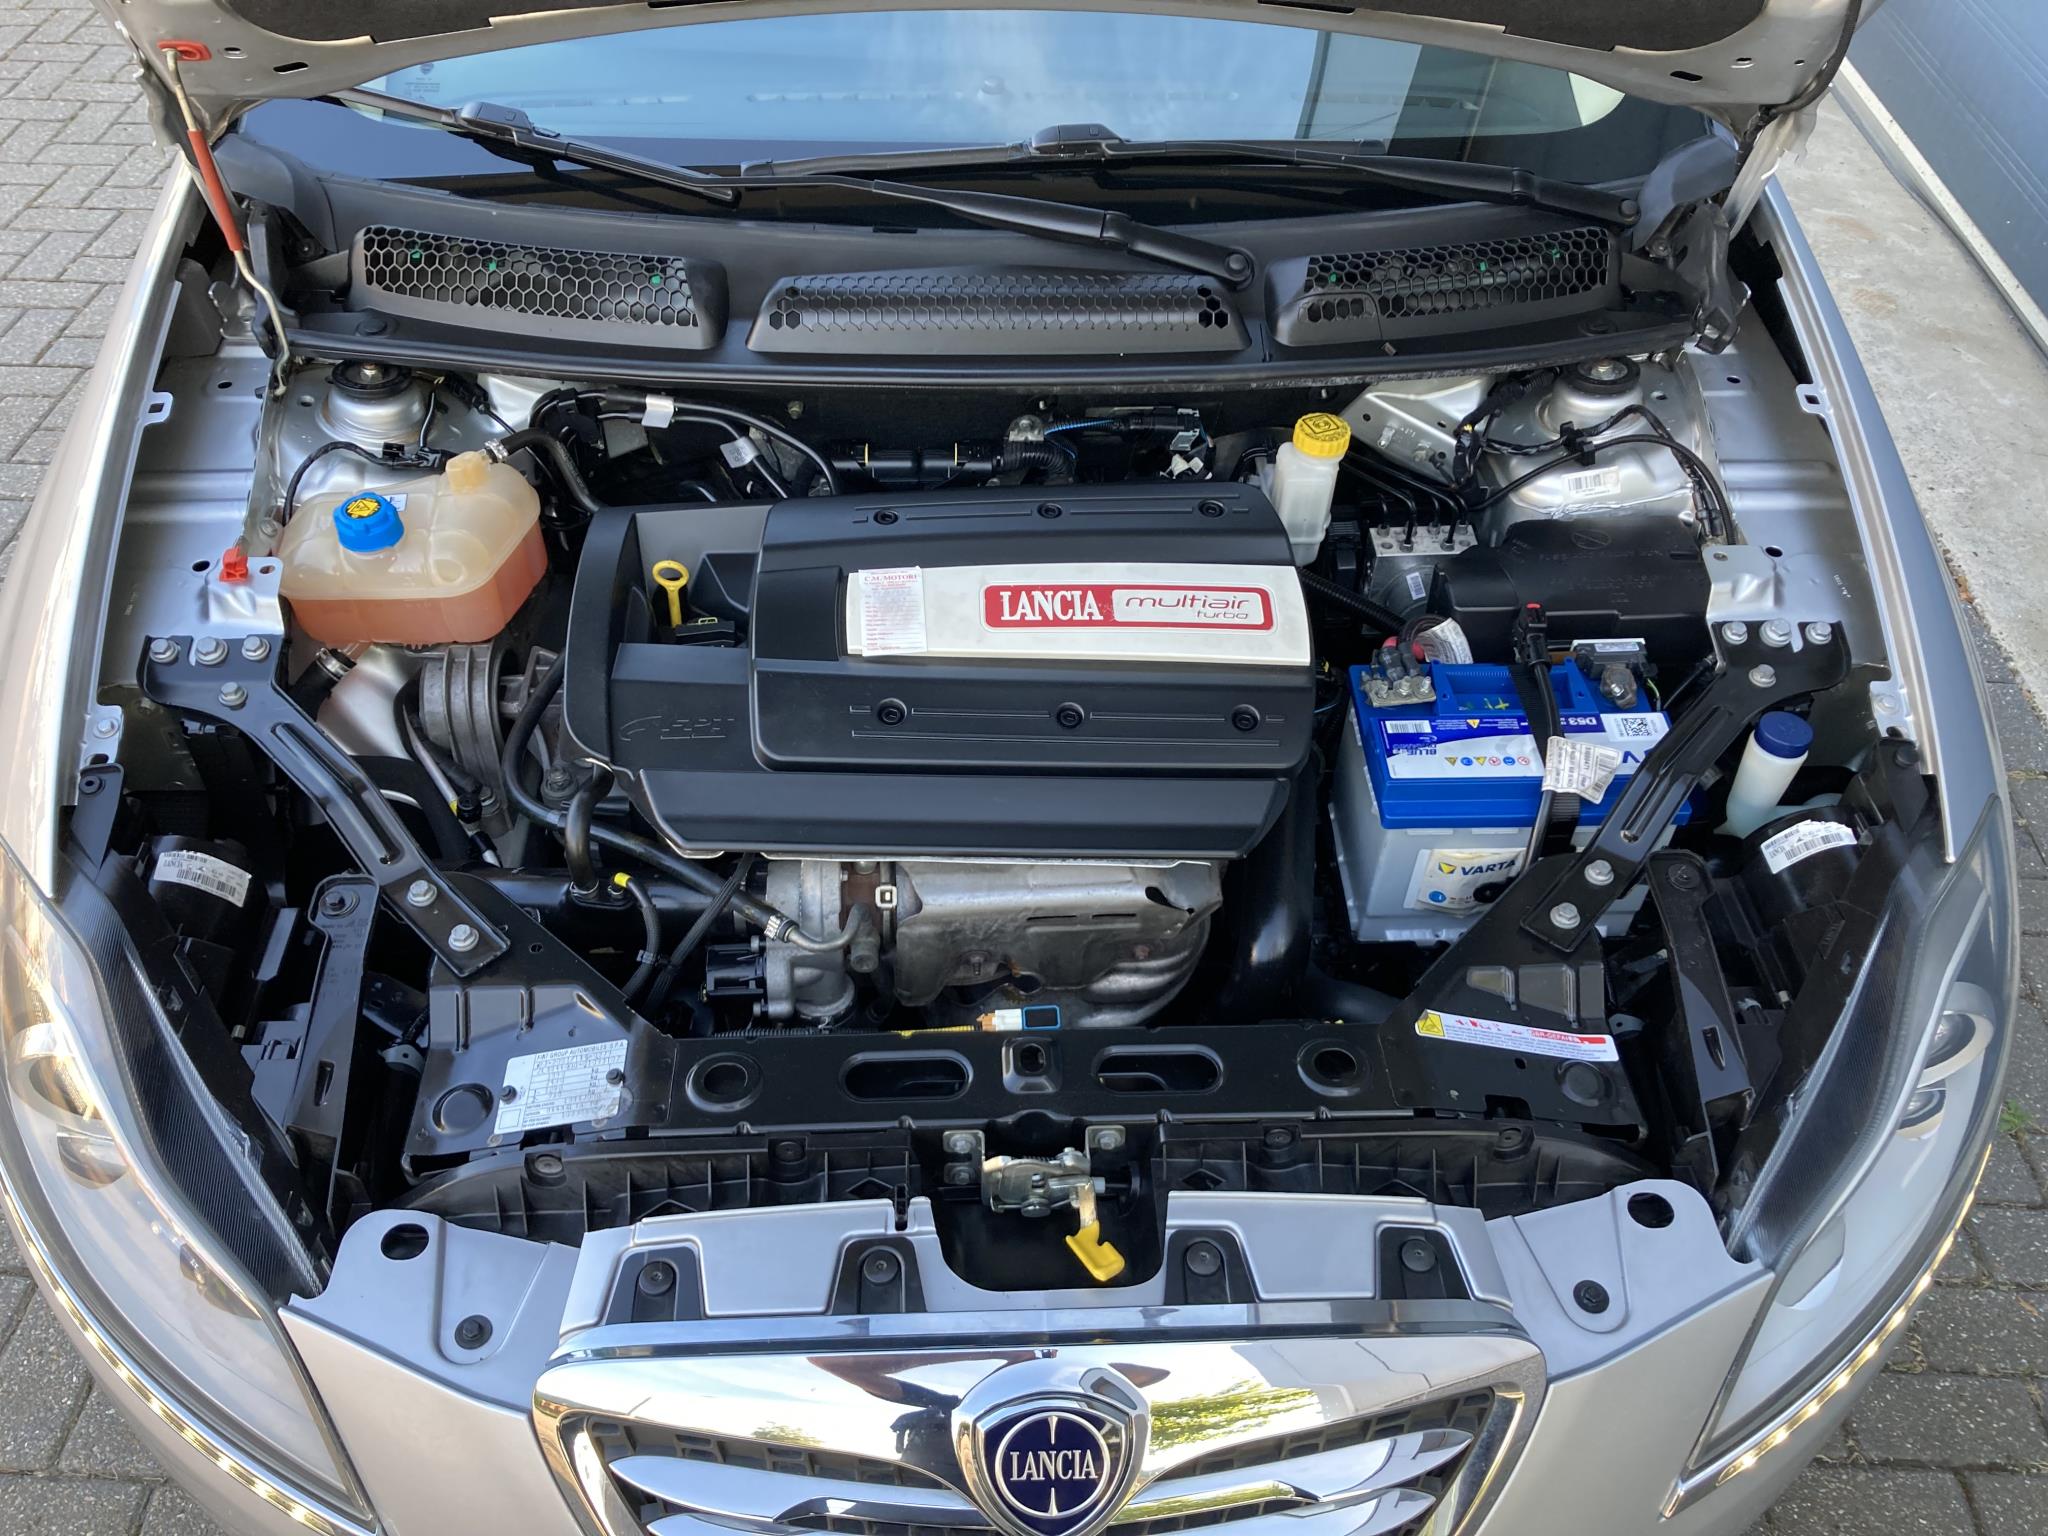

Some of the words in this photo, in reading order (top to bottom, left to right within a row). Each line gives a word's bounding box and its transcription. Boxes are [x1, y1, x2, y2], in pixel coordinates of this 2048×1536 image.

[999, 590, 1104, 621] LANCIA
[1125, 594, 1249, 610] multiair
[1196, 610, 1248, 620] turbo
[1461, 860, 1516, 876] VARTA
[549, 1049, 568, 1058] GROUP
[1009, 1449, 1099, 1481] LANCIA
